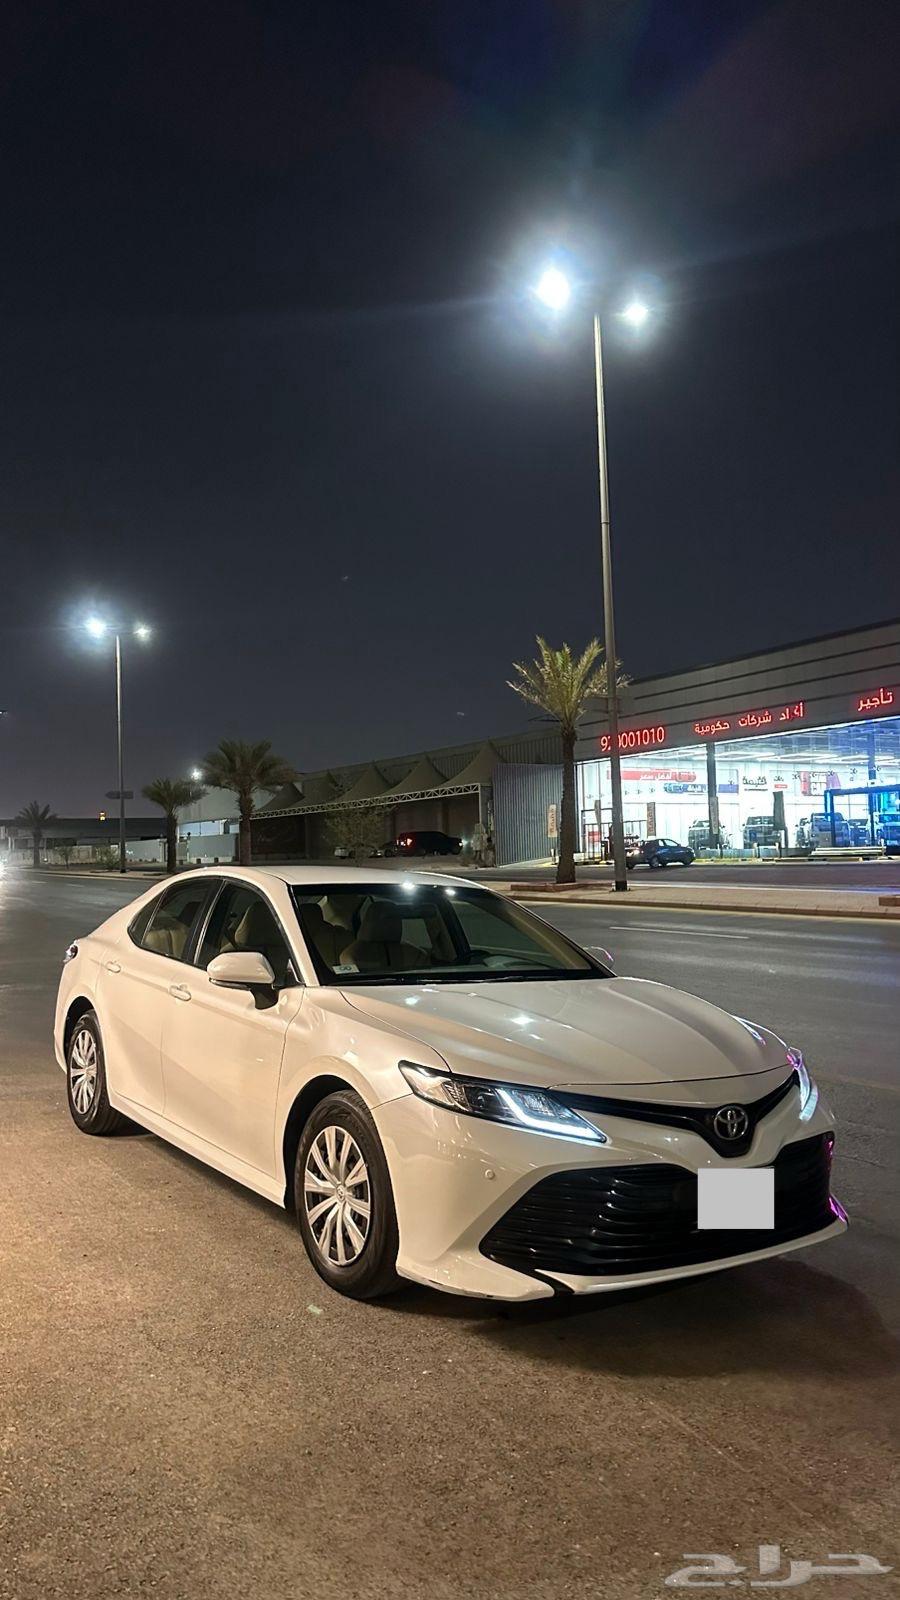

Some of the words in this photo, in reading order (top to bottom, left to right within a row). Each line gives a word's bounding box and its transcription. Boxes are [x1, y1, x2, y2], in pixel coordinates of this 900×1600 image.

[857, 688, 893, 712] تأجير
[738, 710, 772, 727] شركات
[694, 720, 730, 735] حكومية
